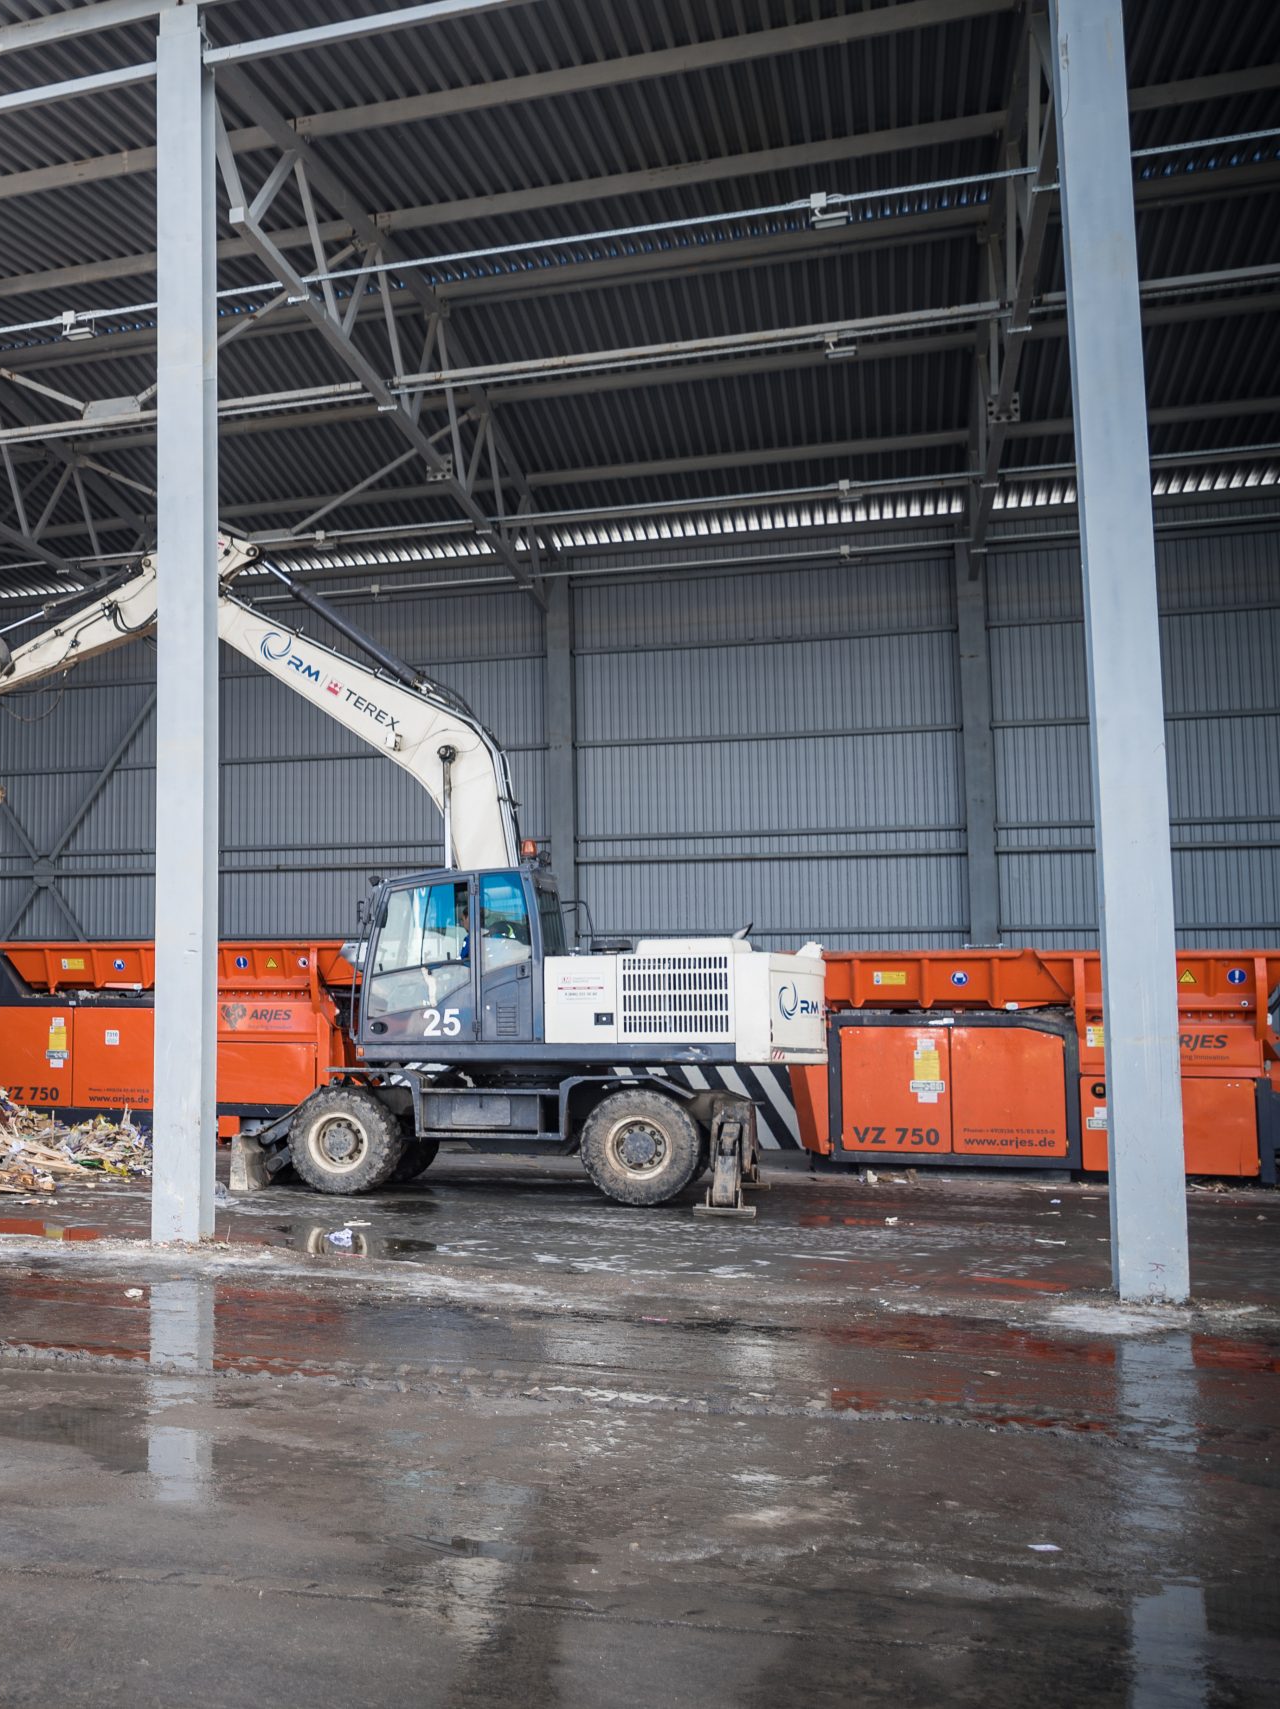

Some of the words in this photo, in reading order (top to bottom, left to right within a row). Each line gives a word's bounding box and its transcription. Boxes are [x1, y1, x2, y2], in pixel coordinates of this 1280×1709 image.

[287, 655, 320, 682] RM
[345, 688, 400, 731] TEREX
[800, 1000, 819, 1014] RM
[250, 1009, 292, 1023] ARJES
[423, 1008, 461, 1036] 25
[1180, 1034, 1228, 1052] RJES
[29, 1087, 59, 1101] 750
[88, 1095, 150, 1104] www.arjes.de
[853, 1126, 886, 1144] VZ
[895, 1128, 940, 1146] 750
[964, 1136, 1055, 1148] www.arjes.de
